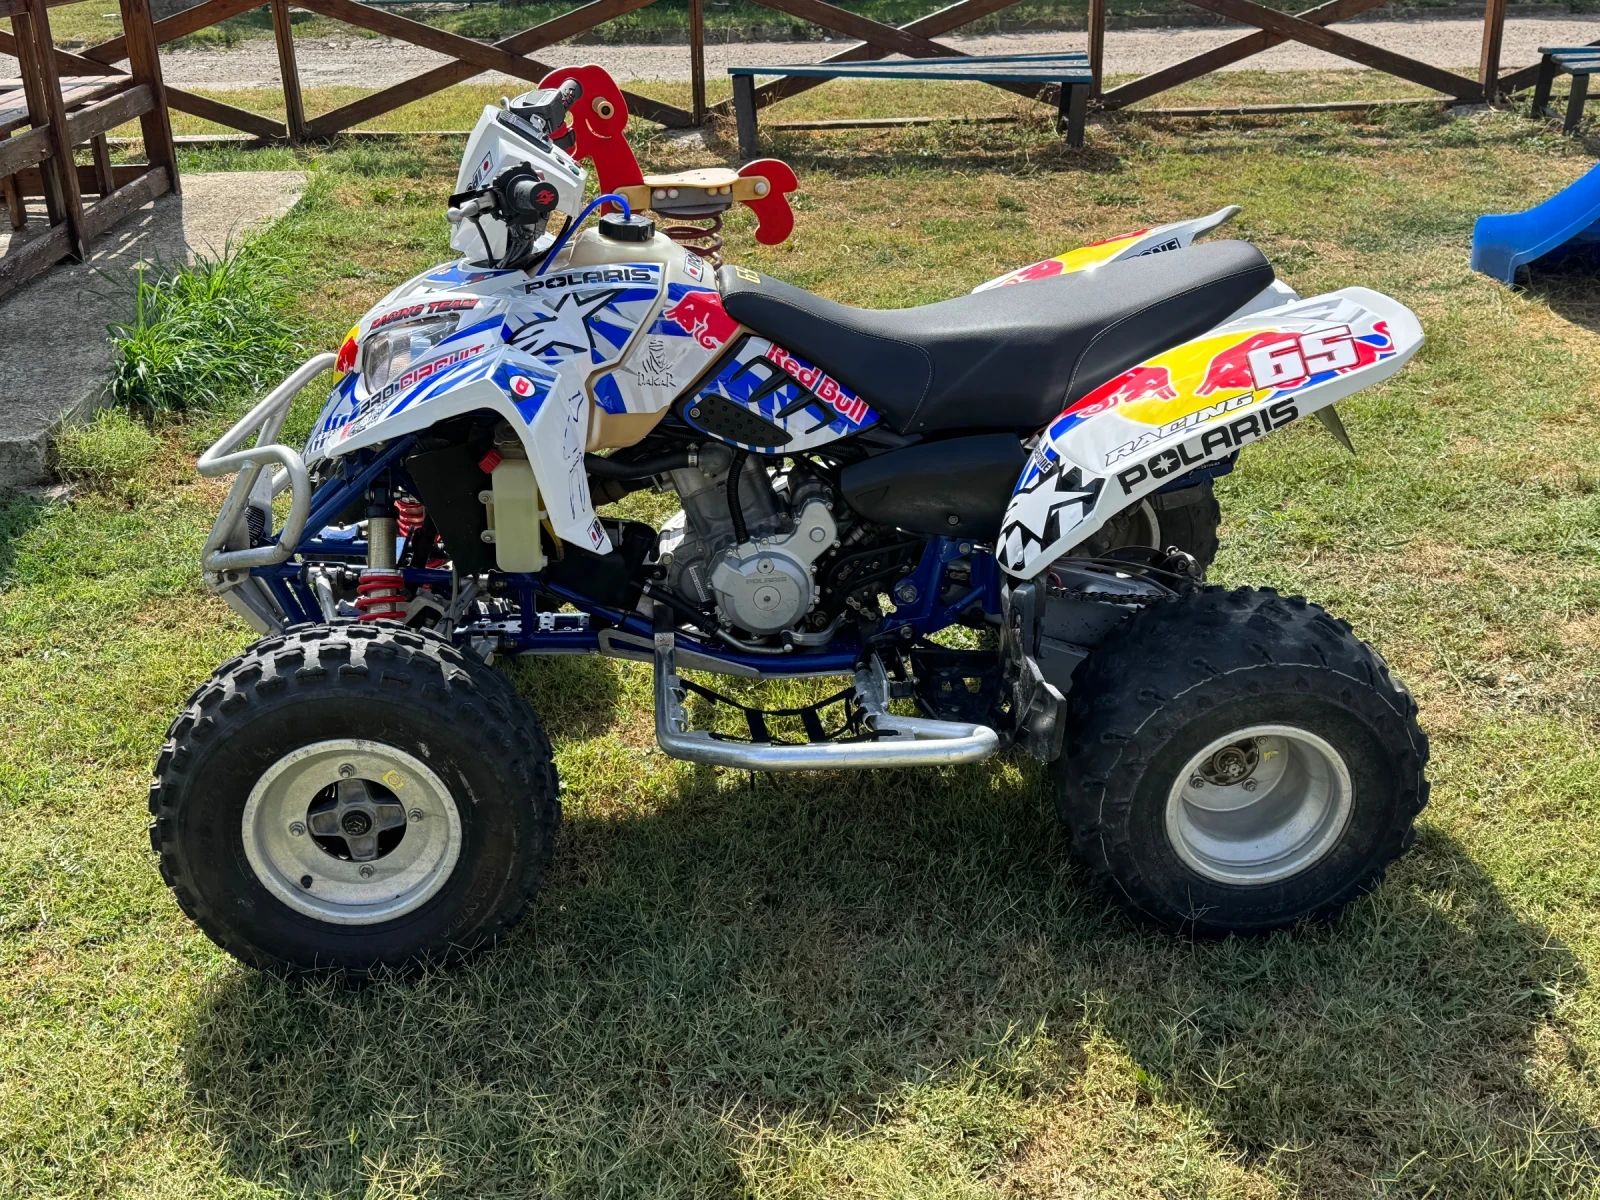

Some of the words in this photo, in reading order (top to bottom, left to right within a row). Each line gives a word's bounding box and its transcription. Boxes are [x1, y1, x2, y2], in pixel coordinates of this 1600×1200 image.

[426, 299, 480, 314] TEAM
[524, 268, 652, 295] POLARIS
[764, 342, 823, 392] Red
[813, 373, 869, 426] Bull
[1245, 324, 1361, 391] 65
[1105, 390, 1255, 468] RACING
[1116, 396, 1300, 497] POLARIS
[745, 576, 788, 585] POLARIS
